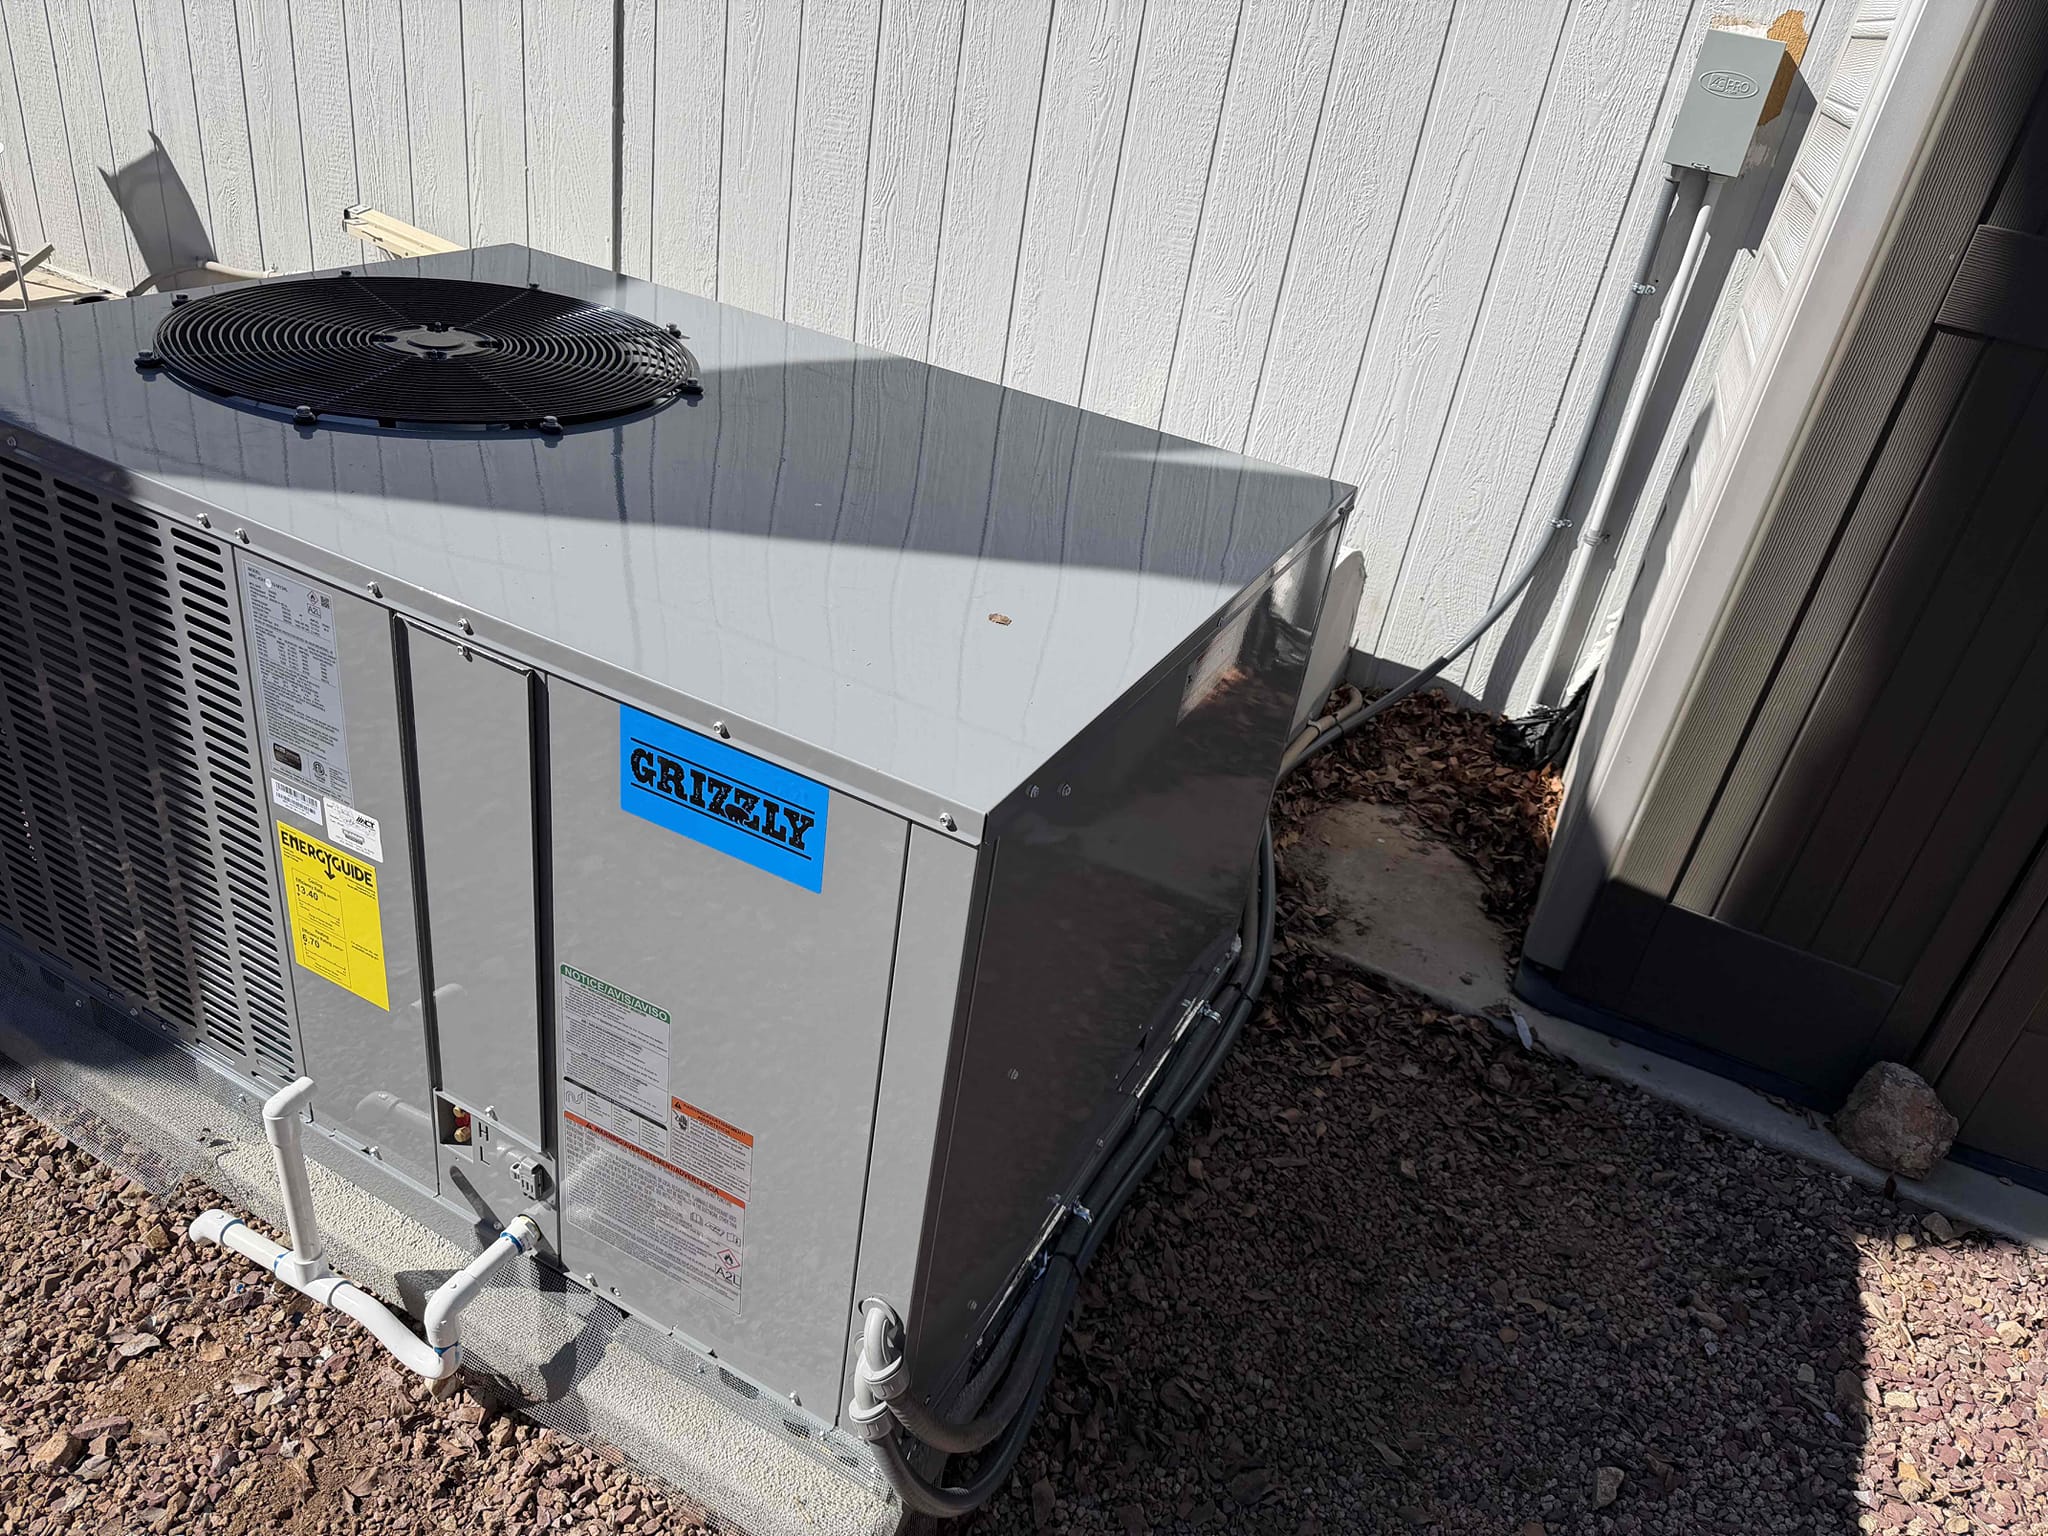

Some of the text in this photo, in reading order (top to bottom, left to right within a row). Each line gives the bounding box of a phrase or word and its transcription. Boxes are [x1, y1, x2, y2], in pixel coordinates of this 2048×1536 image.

[630, 747, 815, 851] GRIZZLY
[280, 830, 374, 888] ENERGYGUIDE
[296, 884, 319, 901] 13.40
[564, 966, 667, 1021] NOTICE/AVIS/AVISO
[716, 1267, 741, 1288] A2L
